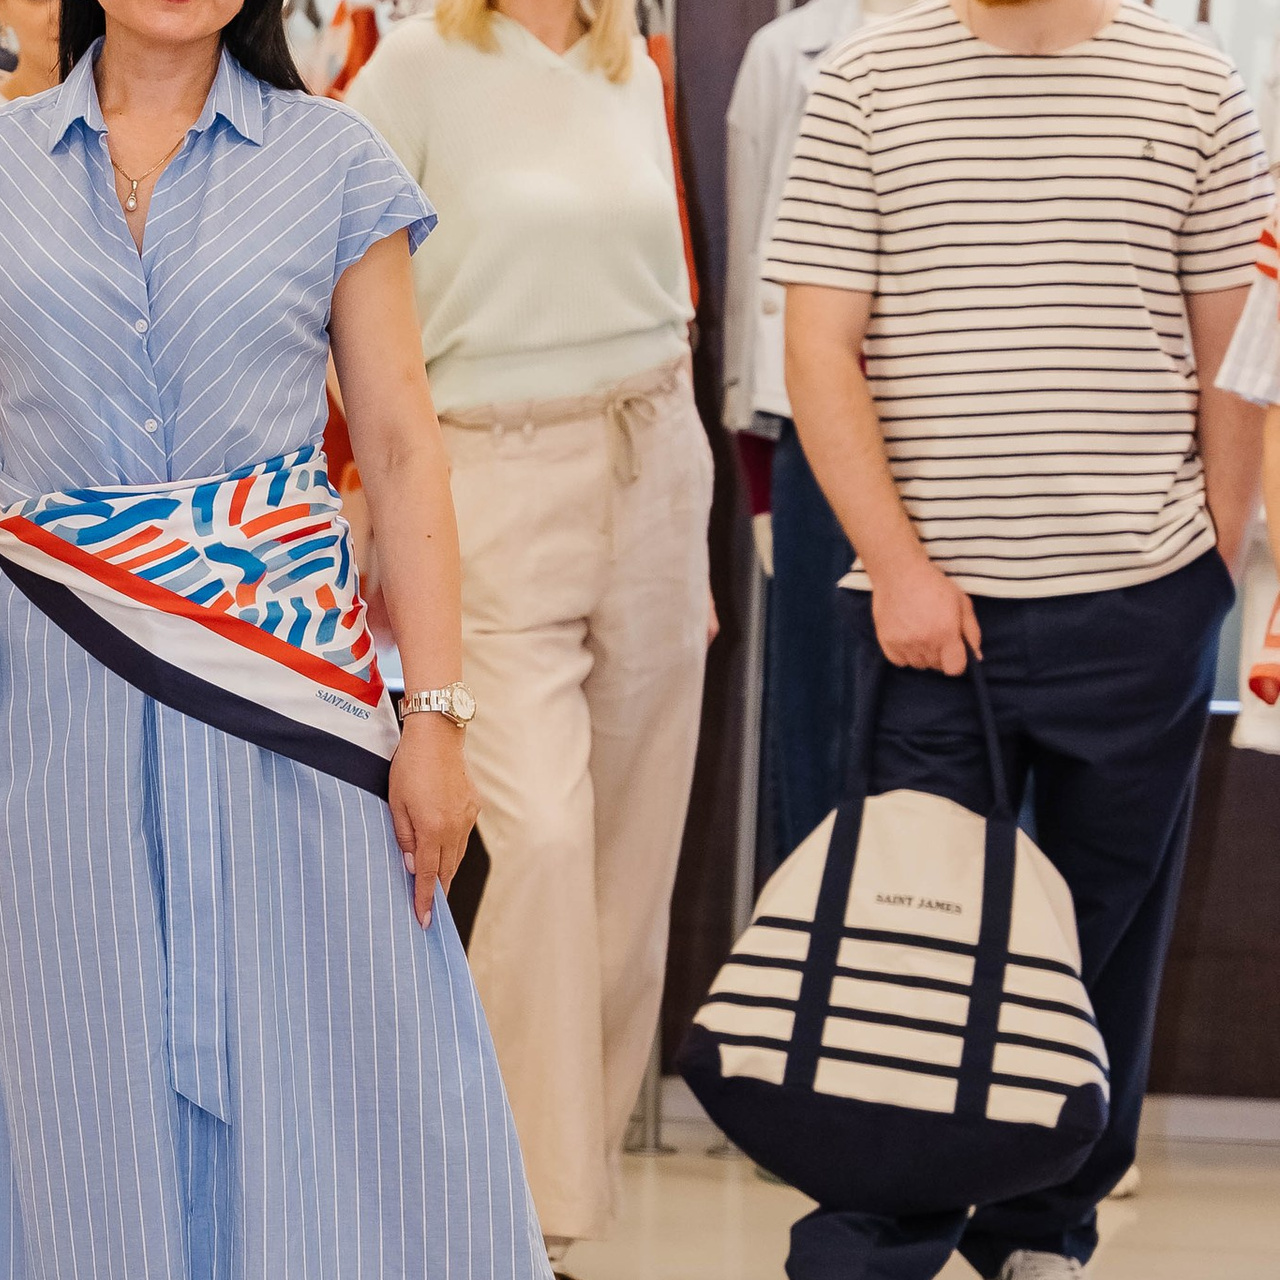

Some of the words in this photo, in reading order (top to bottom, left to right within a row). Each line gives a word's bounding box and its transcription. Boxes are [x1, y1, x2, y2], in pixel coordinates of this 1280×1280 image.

[315, 689, 344, 707] SAINT
[339, 701, 371, 720] JAMES
[875, 893, 913, 907] SAINT
[917, 898, 963, 915] JAMES
